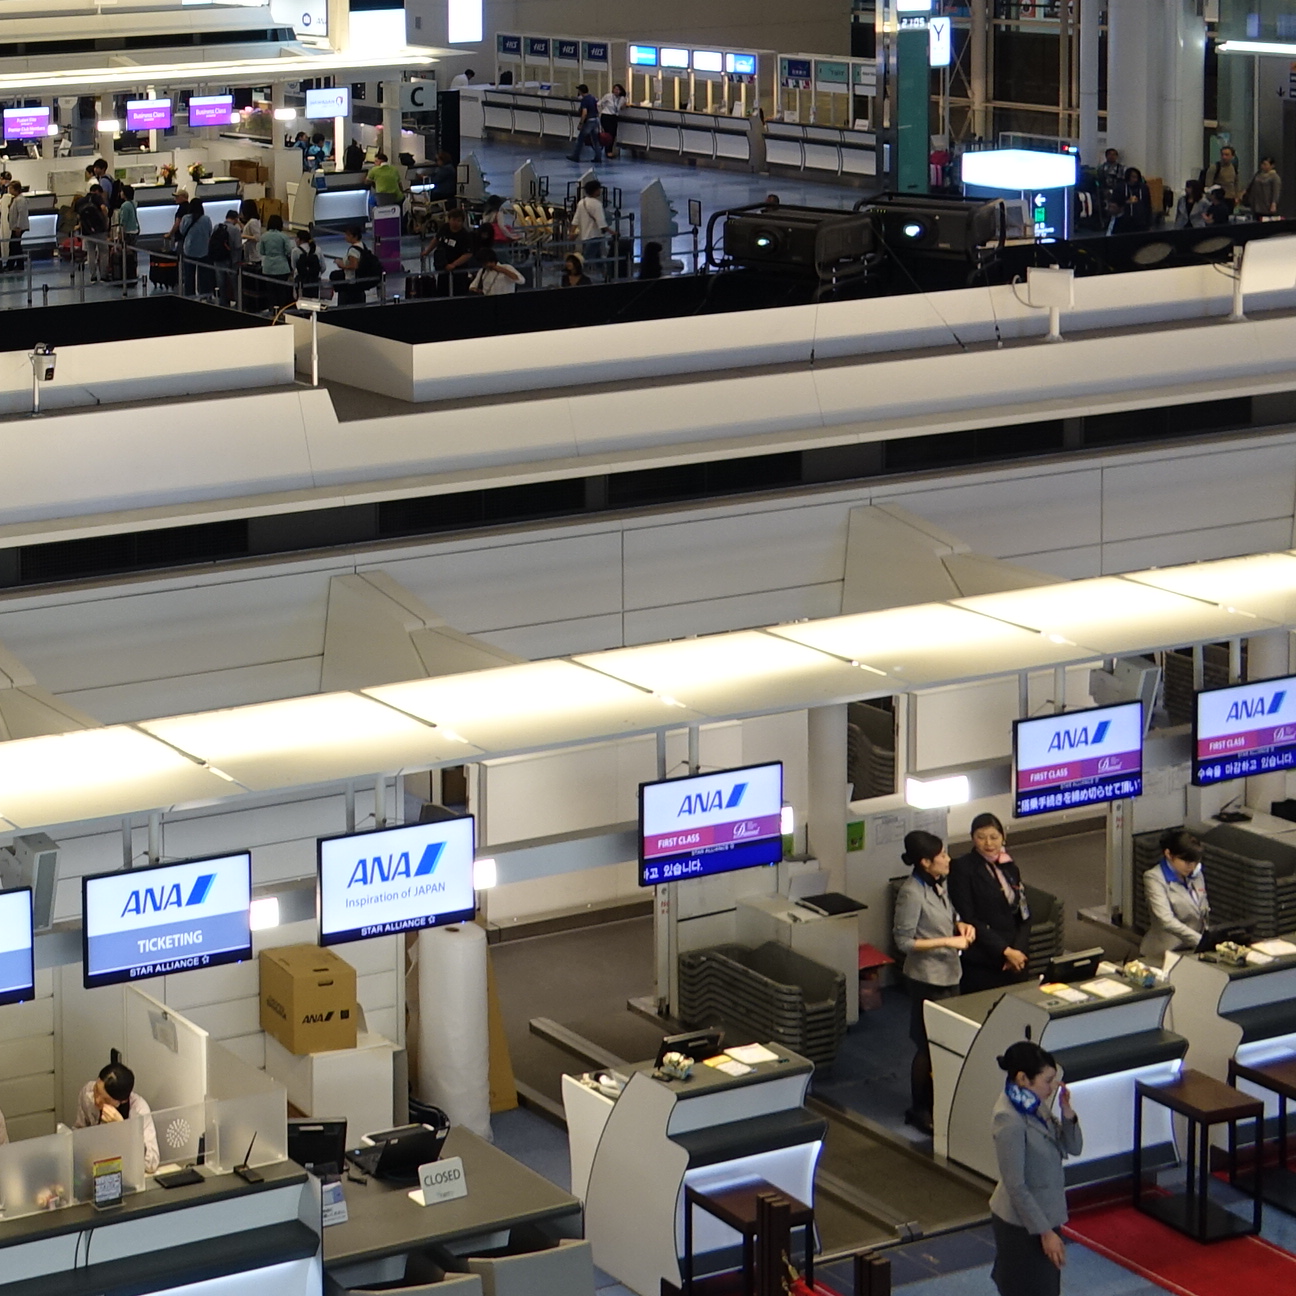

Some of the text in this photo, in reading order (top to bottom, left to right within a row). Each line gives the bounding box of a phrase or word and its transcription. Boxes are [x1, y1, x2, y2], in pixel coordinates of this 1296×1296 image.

[933, 23, 945, 42] Y
[410, 86, 424, 107] C
[1226, 697, 1265, 723] ANA
[1047, 726, 1088, 753] ANA
[1209, 736, 1245, 751] FIRST CLASS
[1030, 767, 1068, 782] FIRST CLASS
[1197, 752, 1294, 780] 수속을 마감하고 있습니다.
[677, 789, 723, 818] ANA
[658, 833, 700, 849] FIRST CLASS
[346, 851, 411, 889] ANA
[663, 858, 703, 878] 있습니다.
[120, 883, 183, 918] ANA
[345, 881, 446, 909] Inspiration of JAPAN
[361, 918, 426, 936] STAR ALLIANCE
[137, 930, 203, 954] TICKETING
[129, 957, 200, 978] STAR ALLIANCE
[302, 1013, 324, 1025] ANA
[424, 1168, 460, 1187] CLOSED
